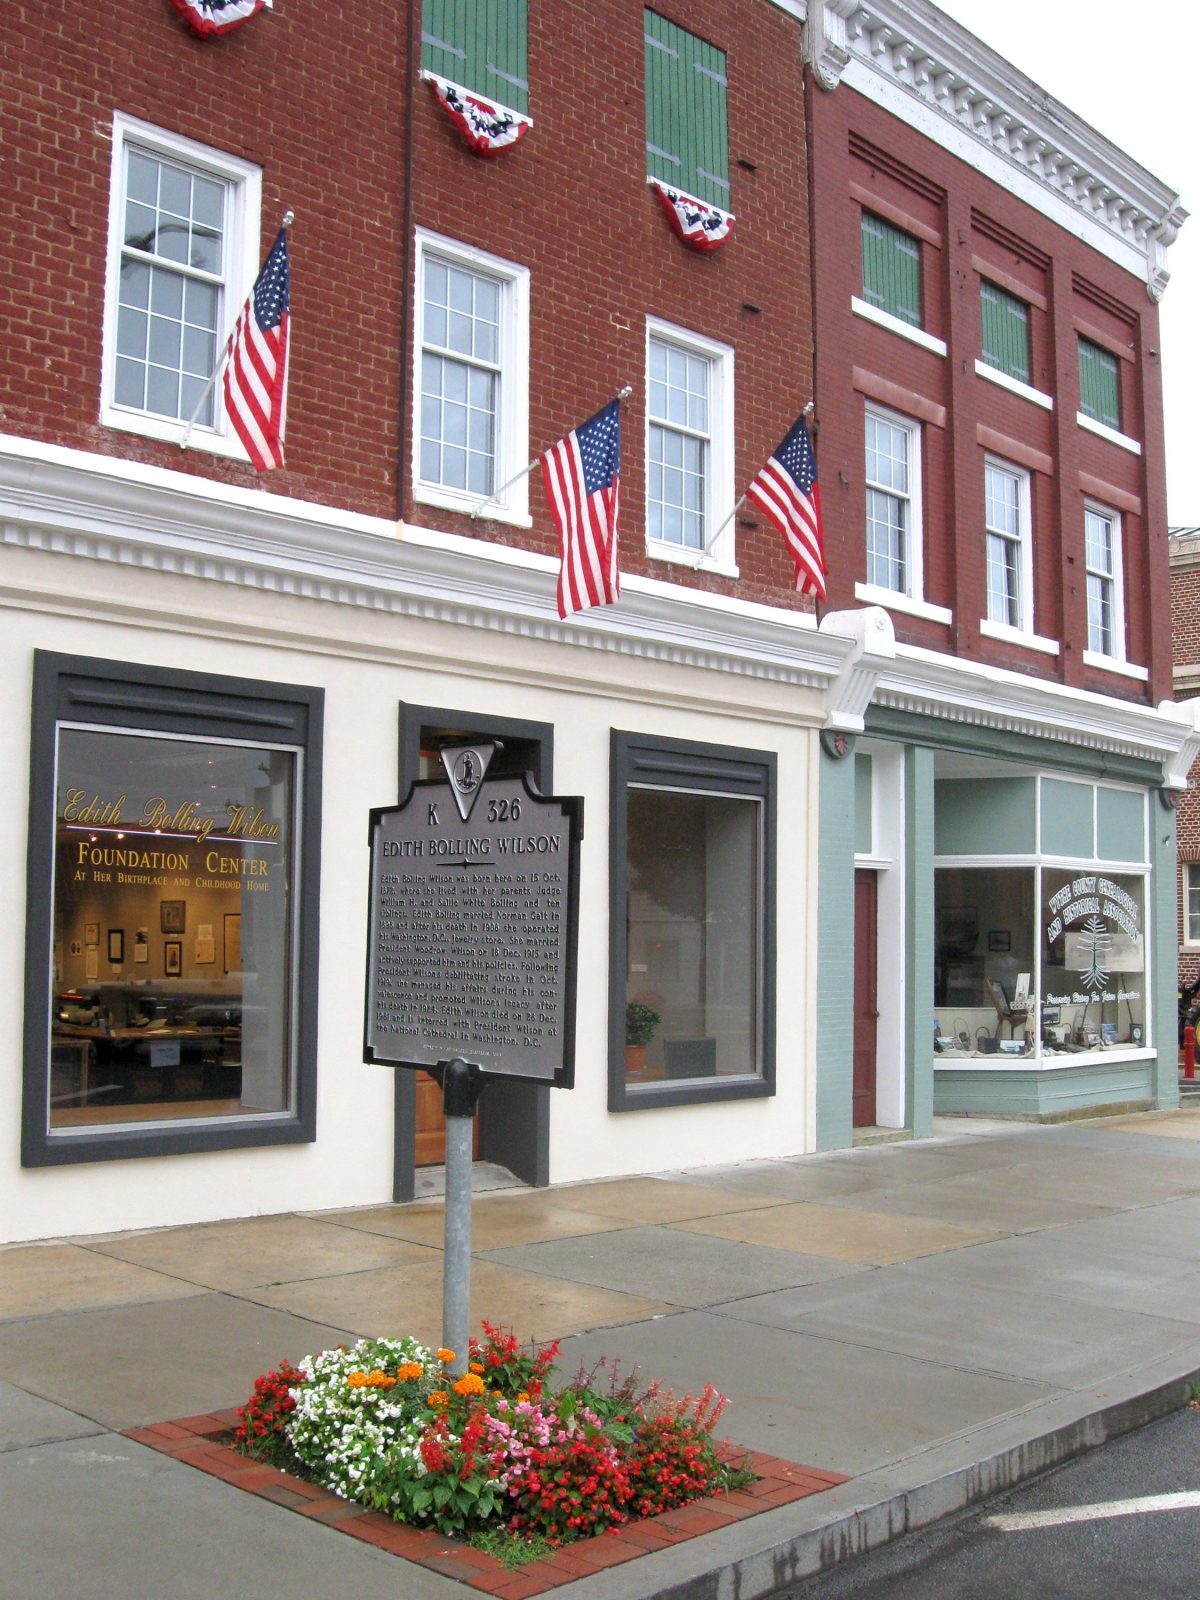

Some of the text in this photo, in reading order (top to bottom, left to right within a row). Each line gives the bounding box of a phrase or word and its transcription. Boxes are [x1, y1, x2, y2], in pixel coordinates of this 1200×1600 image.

[63, 788, 279, 843] Edith Bolling Wilson
[428, 798, 521, 825] K 326
[383, 835, 560, 857] EDITH BOLLING WILSON
[78, 842, 268, 876] FOUNDATION CENTER
[381, 874, 400, 884] Edith
[403, 875, 426, 885] Bolling
[429, 874, 453, 882] Wilson
[473, 874, 490, 882] born
[495, 874, 512, 882] here
[543, 873, 562, 882] Oct.
[438, 886, 457, 894] lived
[462, 886, 478, 894] with
[483, 886, 495, 894] her
[501, 888, 531, 896] parents
[537, 886, 561, 896] Judge
[1049, 884, 1071, 914] WYTHE
[1073, 877, 1096, 896] COUNTY
[380, 898, 405, 906] William
[421, 899, 433, 907] and
[438, 898, 458, 907] Sallie
[463, 898, 485, 907] White
[491, 898, 518, 908] Bolling
[524, 898, 540, 907] and
[547, 899, 560, 908] ten
[412, 910, 432, 918] Edith
[436, 910, 460, 920] Bolling
[464, 911, 494, 919] married
[497, 911, 528, 920] Norman
[551, 912, 560, 921] in
[1048, 917, 1062, 943] AND
[1063, 898, 1099, 925] HISTORICAL
[397, 921, 408, 930] and
[412, 921, 429, 930] after
[432, 922, 443, 931] his
[446, 922, 467, 931] death
[470, 923, 478, 931] in
[504, 923, 517, 932] she
[522, 924, 560, 934] operated
[510, 936, 523, 945] She
[526, 936, 560, 946] married
[378, 944, 411, 953] President
[414, 945, 446, 954] Woodrow
[451, 946, 476, 956] Wilson
[478, 948, 488, 956] on
[544, 950, 560, 959] and
[406, 957, 441, 967] supported
[443, 958, 456, 967] him
[458, 959, 470, 967] and
[473, 959, 483, 968] his
[521, 962, 559, 973] Following
[377, 967, 409, 976] President
[445, 970, 489, 982] debilitating
[495, 973, 521, 983] stroke
[526, 974, 534, 984] in
[445, 982, 456, 990] his
[462, 983, 487, 992] affairs
[492, 984, 517, 996] during
[522, 987, 534, 996] his
[415, 992, 428, 1001] and
[431, 994, 466, 1004] promoted
[504, 999, 530, 1009] legacy
[537, 1000, 558, 1010] after
[389, 1002, 408, 1011] death
[410, 1003, 418, 1012] in
[442, 1006, 462, 1016] Edith
[465, 1008, 490, 1017] Wilson
[492, 1010, 509, 1019] died
[512, 1012, 522, 1021] on
[390, 1024, 419, 1035] National
[422, 1028, 458, 1039] Cathedral
[461, 1031, 470, 1040] in
[392, 1013, 405, 1022] and
[418, 1015, 448, 1026] interred
[453, 1018, 470, 1028] with
[474, 1021, 511, 1031] President
[516, 1024, 544, 1035] Wilson
[548, 1027, 557, 1036] at
